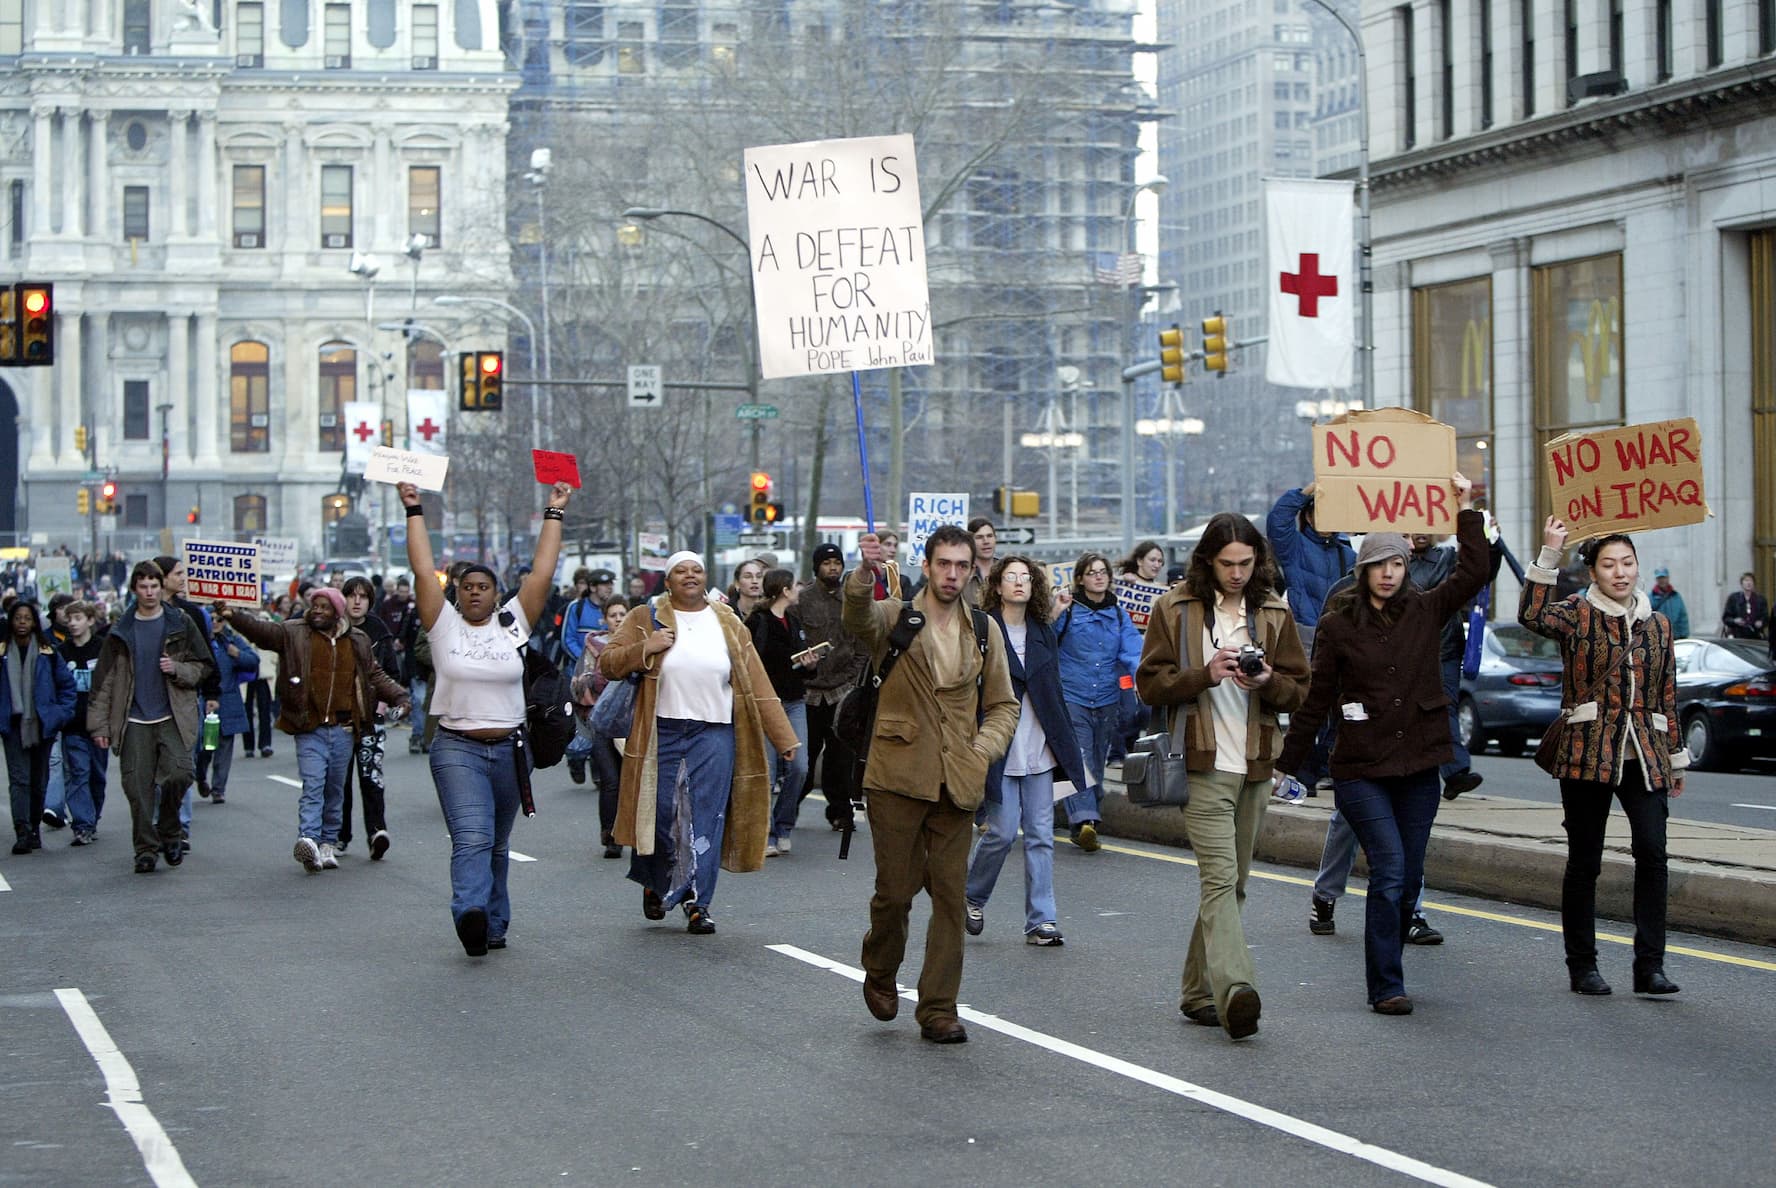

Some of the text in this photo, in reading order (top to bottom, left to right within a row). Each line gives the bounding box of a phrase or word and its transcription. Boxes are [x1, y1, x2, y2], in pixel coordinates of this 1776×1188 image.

[754, 156, 901, 201] WAR IS
[758, 225, 918, 272] A DEFEAT
[812, 271, 876, 313] FOR
[789, 301, 931, 350] HUMANITY
[807, 340, 932, 372] POPE John Paul
[633, 368, 656, 379] ONE
[634, 380, 657, 389] WAY
[737, 409, 766, 418] ARCH
[1326, 430, 1396, 469] NO
[1551, 428, 1697, 487] NO WAR
[914, 497, 963, 515] RICH
[1357, 480, 1451, 527] WAR
[1610, 478, 1703, 520] IRAQ
[187, 567, 256, 583] PATRIOTIC
[189, 554, 233, 568] PEACE
[239, 558, 252, 569] IS
[189, 582, 256, 599] NO WAR ON IRAQ
[1115, 587, 1153, 603] EACE
